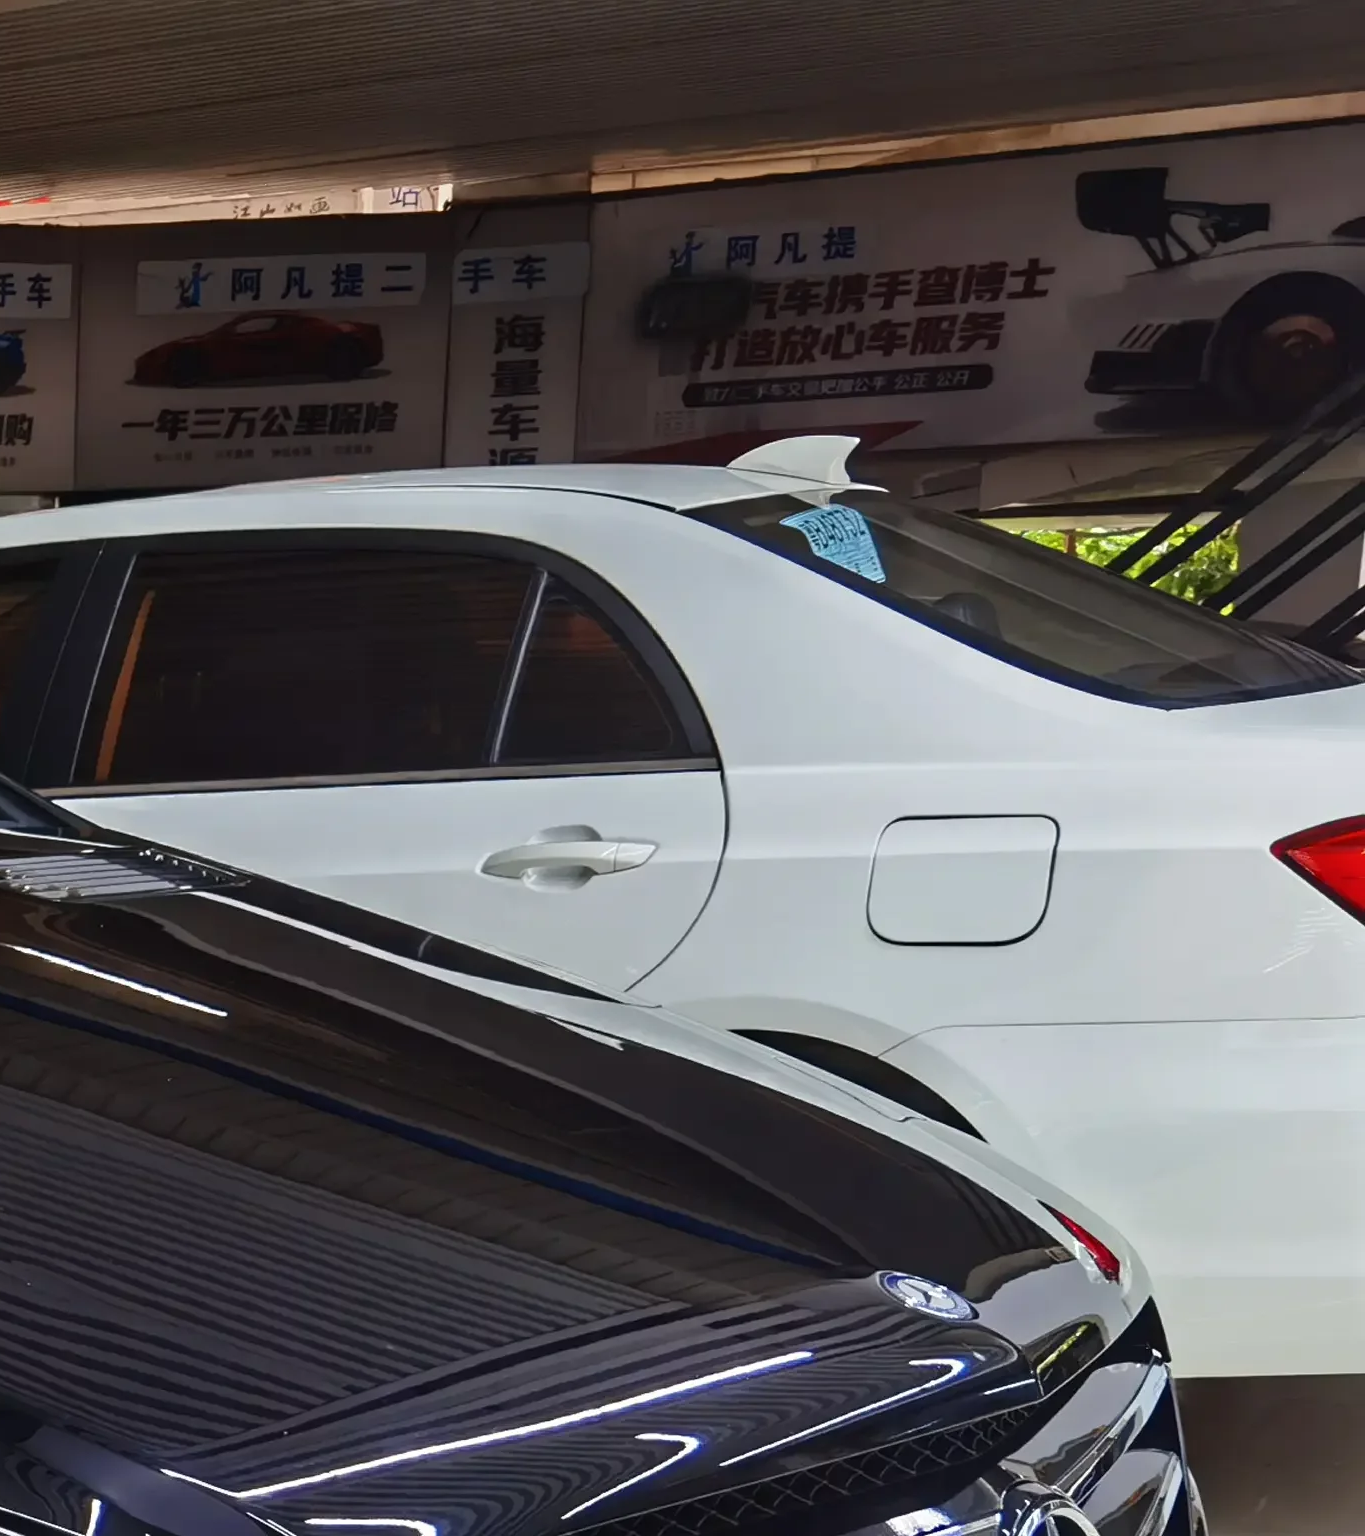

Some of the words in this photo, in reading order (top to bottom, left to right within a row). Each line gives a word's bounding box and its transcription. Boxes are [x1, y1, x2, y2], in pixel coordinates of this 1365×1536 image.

[726, 226, 858, 269] 阿凡提
[121, 399, 400, 442] 一年三万公里保修
